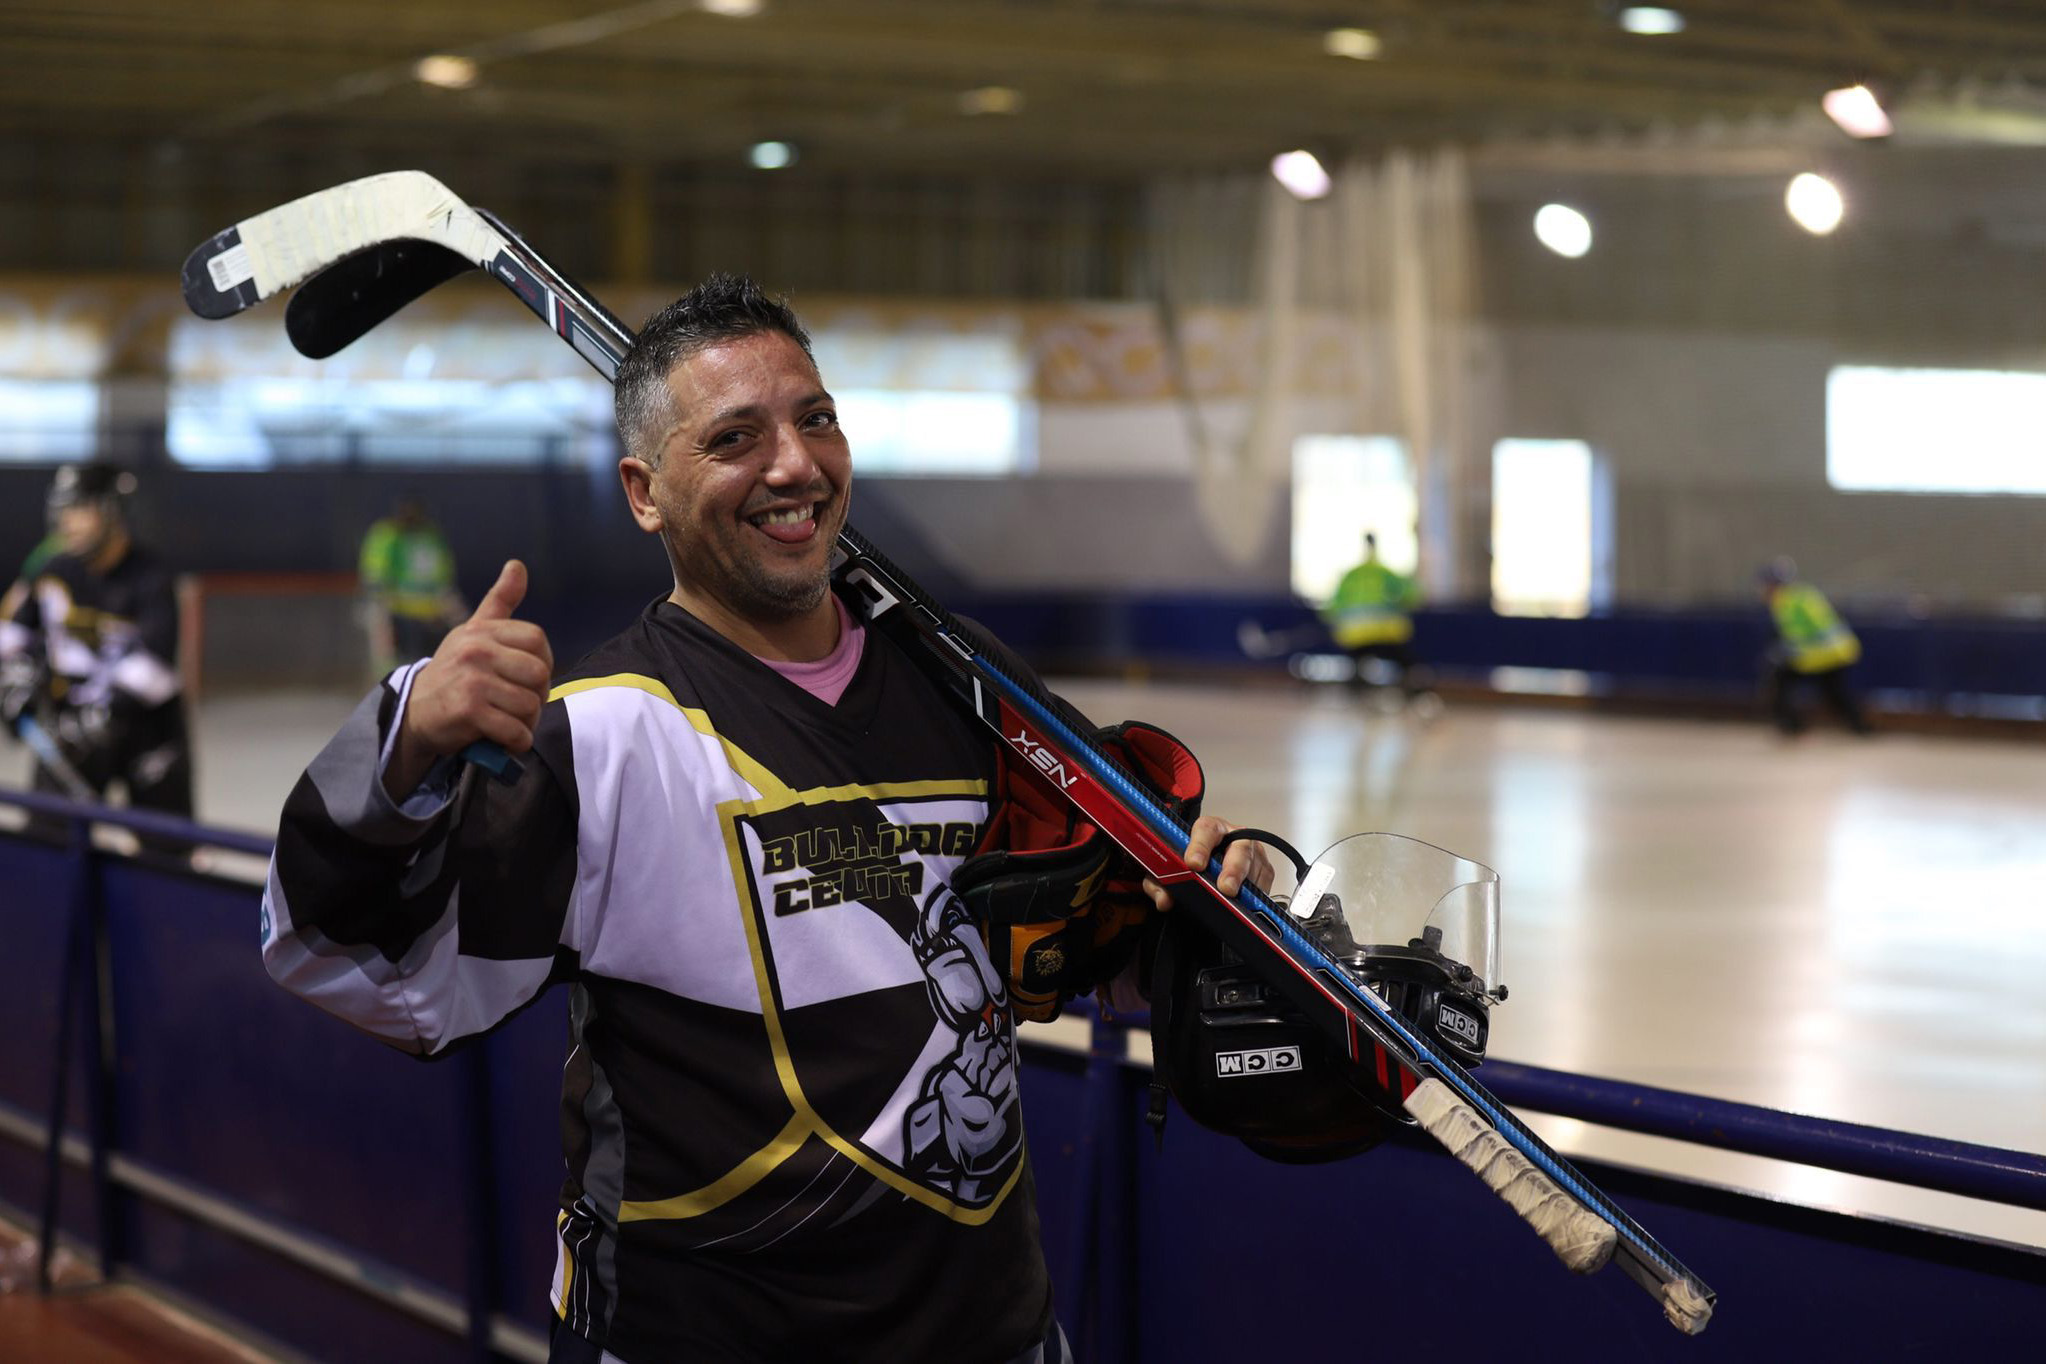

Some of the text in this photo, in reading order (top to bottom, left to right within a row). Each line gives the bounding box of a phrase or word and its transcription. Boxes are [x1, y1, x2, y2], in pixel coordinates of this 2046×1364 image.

[1009, 729, 1078, 789] NSX
[762, 822, 984, 875] BULLDOG
[774, 862, 923, 917] CEUTA
[1440, 1006, 1477, 1041] CCM
[1217, 1049, 1299, 1076] CCM
